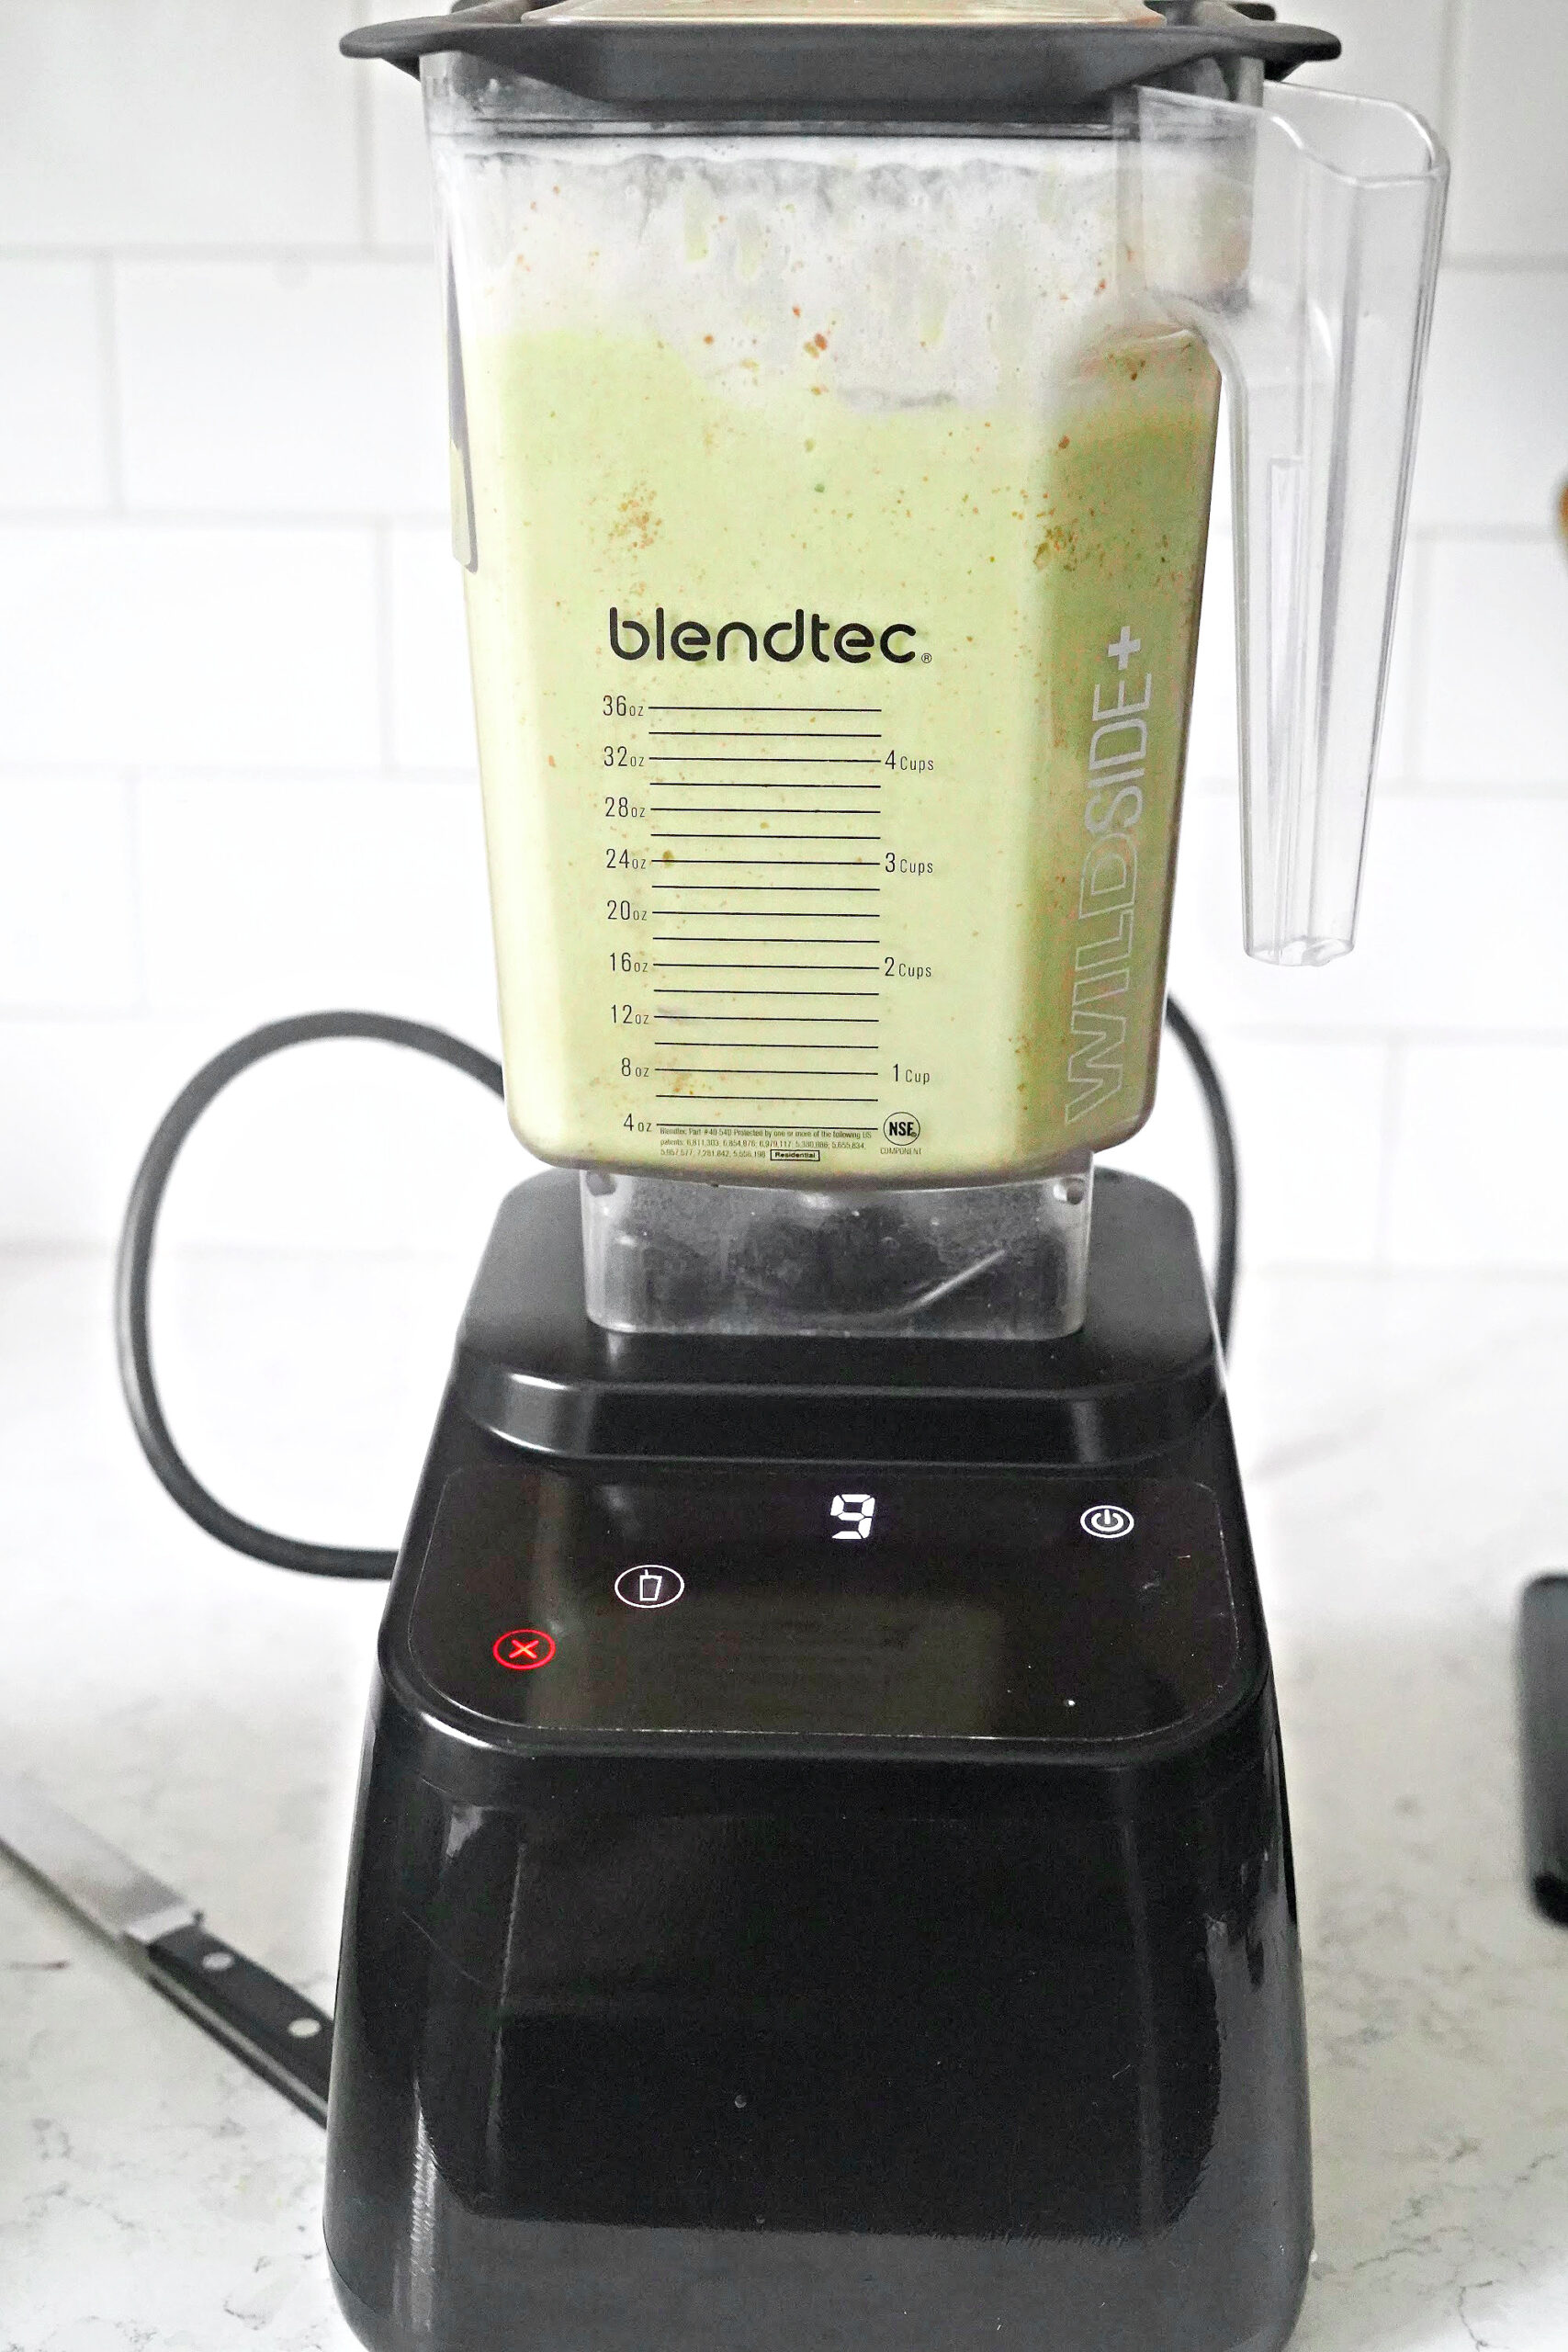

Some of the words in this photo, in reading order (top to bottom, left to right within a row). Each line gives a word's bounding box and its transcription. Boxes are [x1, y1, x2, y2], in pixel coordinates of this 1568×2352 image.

[885, 749, 897, 770] 4
[900, 755, 934, 775] Cups
[885, 852, 896, 873] 3
[899, 858, 933, 876] Cups
[884, 956, 896, 977] 2
[898, 963, 931, 980] Cups
[892, 1063, 898, 1082] 1
[905, 1069, 931, 1085] Cup
[764, 1129, 772, 1138] by
[821, 1130, 831, 1138] the
[832, 1131, 861, 1139] following
[829, 1494, 875, 1540] 9
